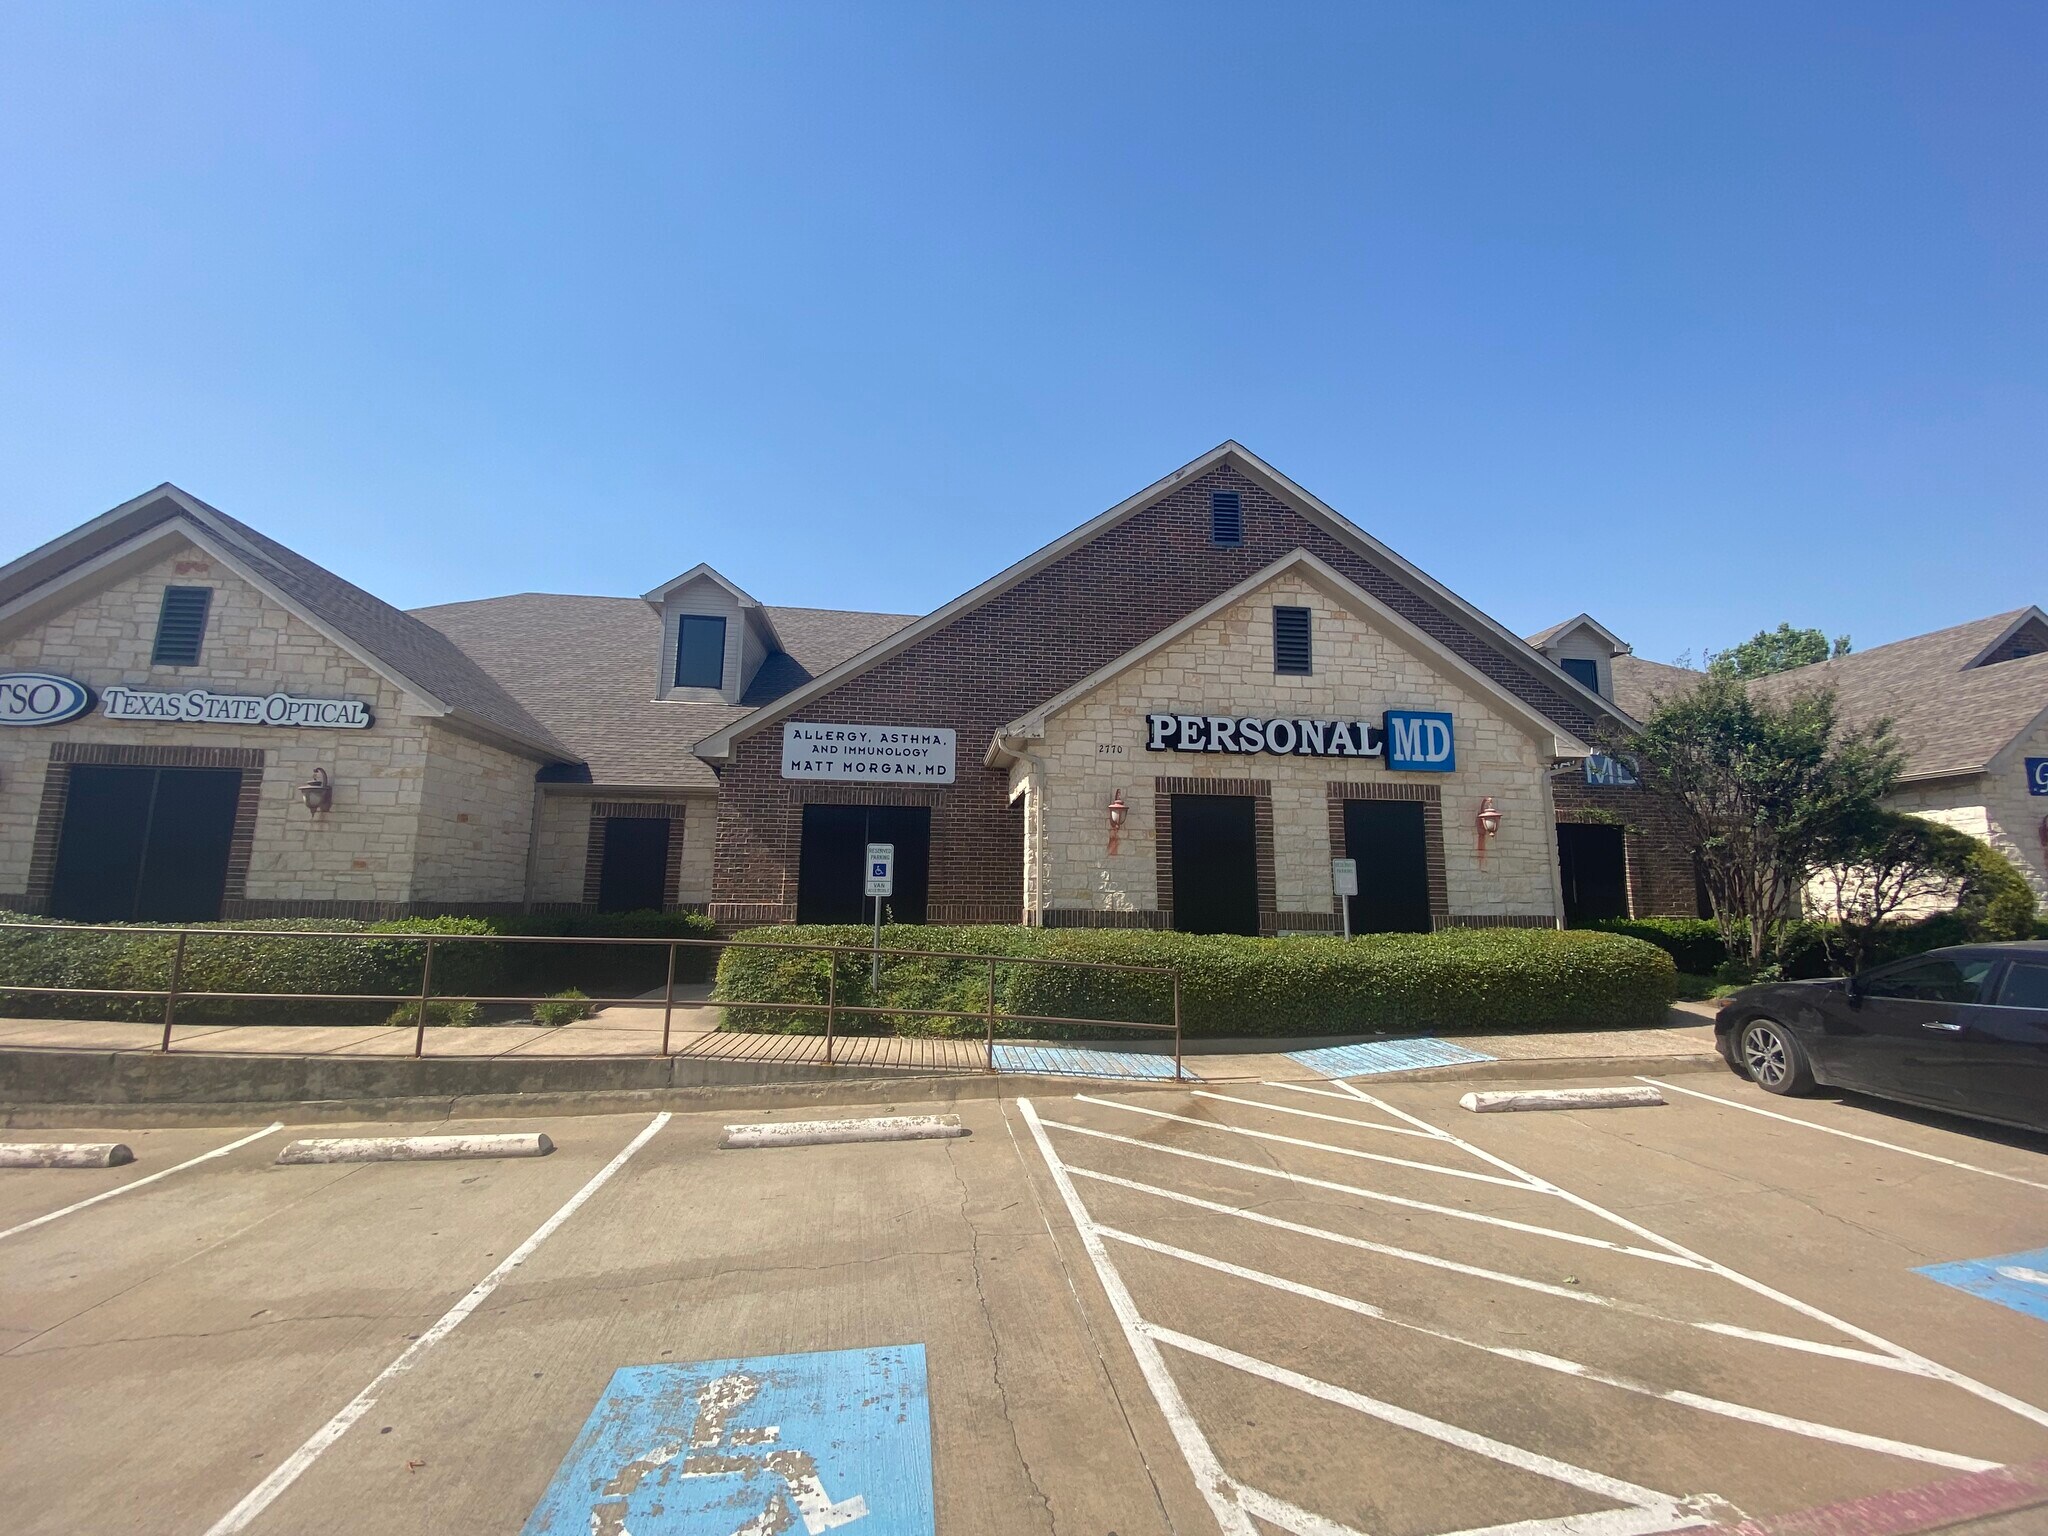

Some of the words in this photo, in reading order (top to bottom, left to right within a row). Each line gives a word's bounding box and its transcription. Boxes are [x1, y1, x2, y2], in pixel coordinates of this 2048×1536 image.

[0, 684, 61, 714] TSO
[793, 729, 872, 743] ALLERGY,
[880, 733, 947, 746] ASTHMA,
[1149, 714, 1382, 756] PERSONAL
[1392, 717, 1450, 763] MD
[812, 744, 838, 754] AND
[844, 746, 929, 757] IMMUNOLOGY
[1099, 744, 1123, 754] 2770
[791, 760, 834, 772] MATT
